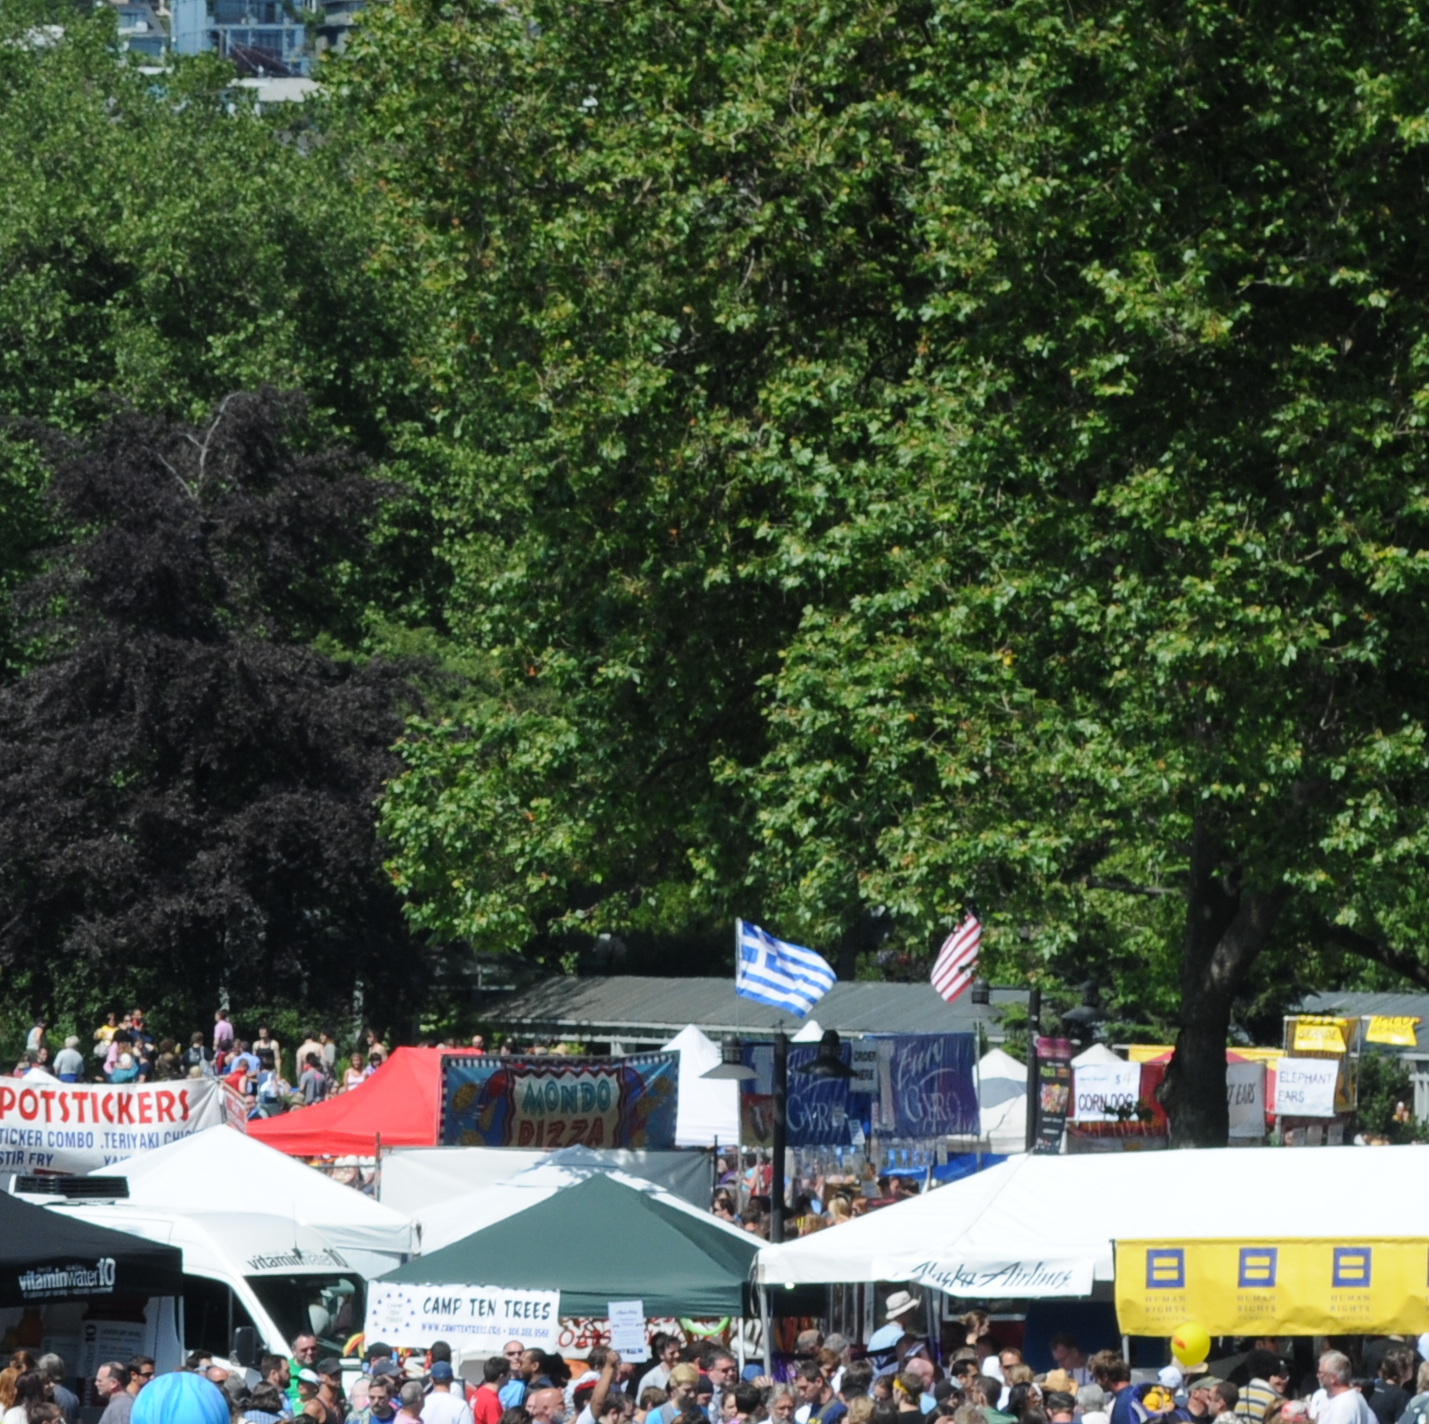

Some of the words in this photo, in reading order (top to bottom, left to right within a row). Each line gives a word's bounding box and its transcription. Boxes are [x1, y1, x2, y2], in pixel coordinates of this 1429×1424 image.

[1279, 1071, 1333, 1085] ELEPHANT
[522, 1079, 611, 1114] MONDO
[1277, 1090, 1305, 1103] EARS
[518, 1117, 605, 1147] PIZZA
[47, 1130, 94, 1149] COMBO
[28, 1151, 54, 1167] FRY
[911, 1260, 976, 1288] Alaska
[979, 1261, 1075, 1290] Airlines
[1145, 1295, 1186, 1303] HUMAN
[1237, 1294, 1275, 1302] HUMAN
[1330, 1294, 1370, 1302] HUMAN
[423, 1296, 462, 1317] CAMP
[470, 1297, 498, 1318] TEN
[504, 1300, 552, 1321] TREES
[1145, 1305, 1186, 1313] RIGHTS
[1237, 1304, 1275, 1312] RIGHTS
[1330, 1304, 1370, 1312] RIGHTS
